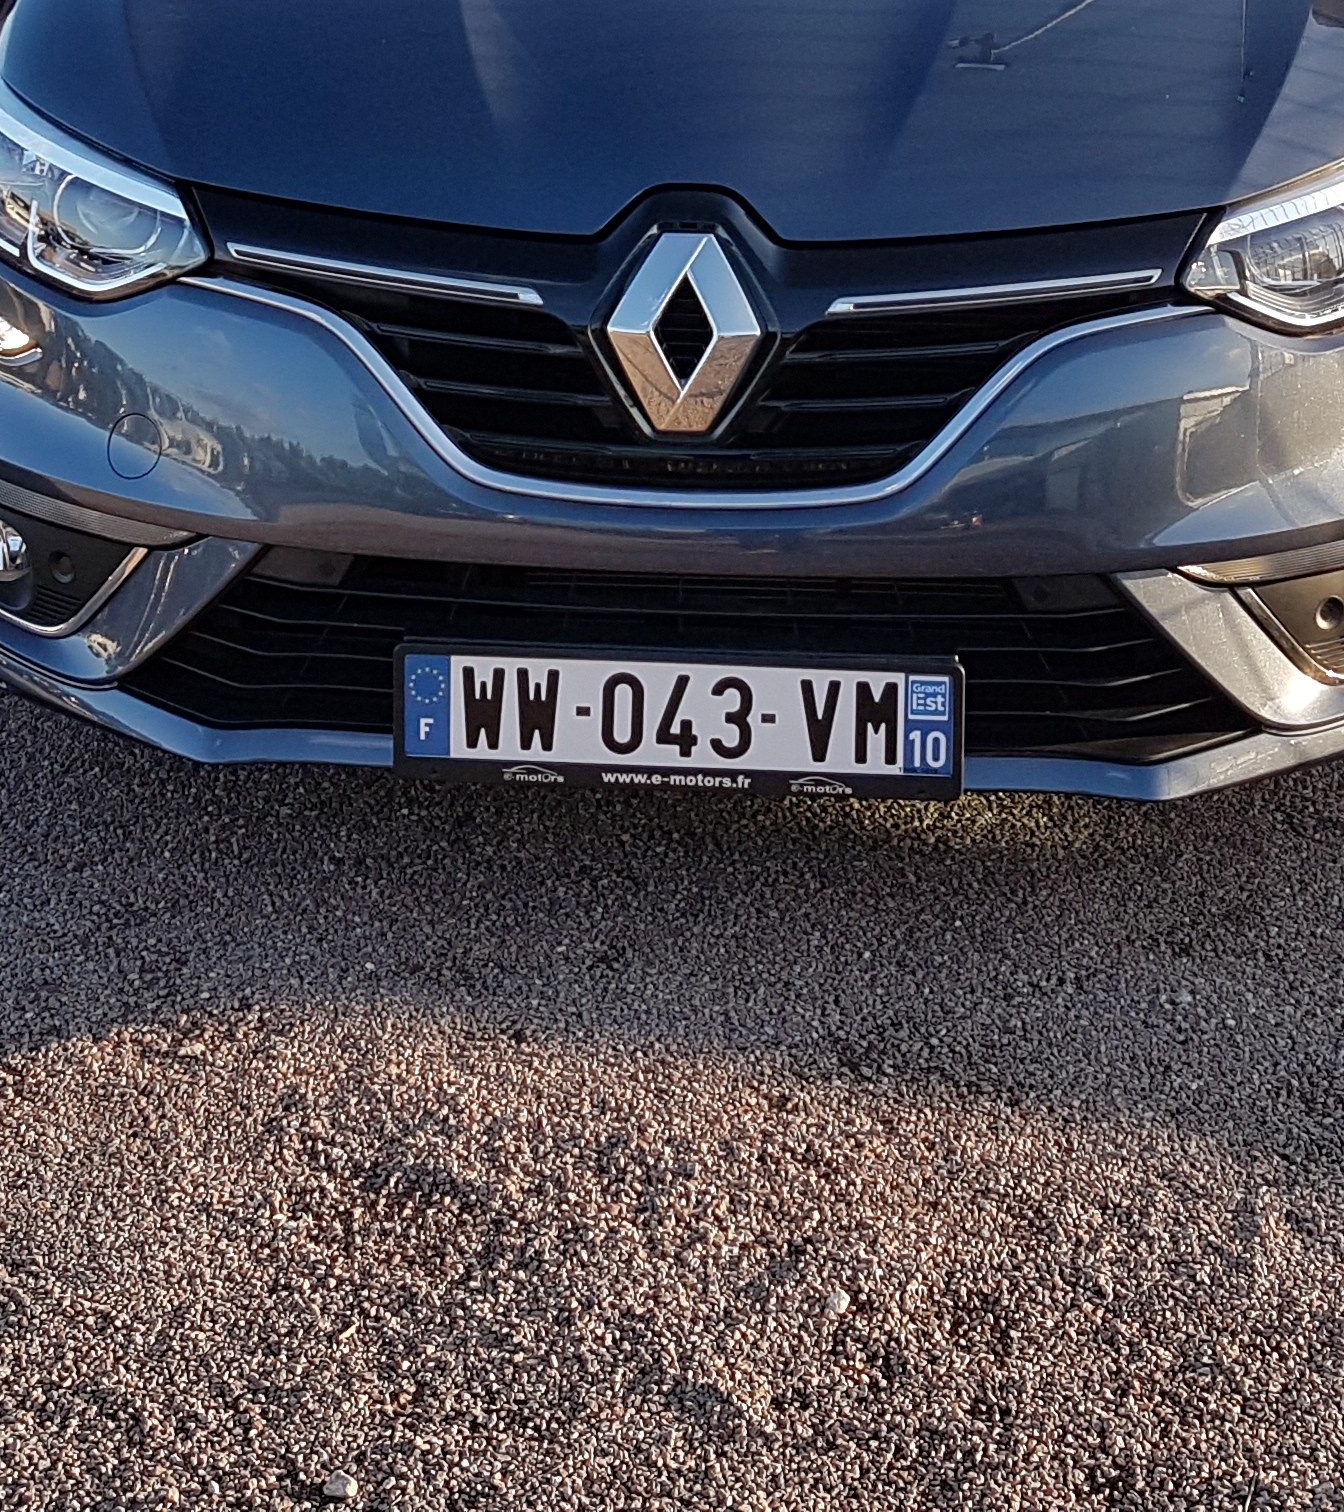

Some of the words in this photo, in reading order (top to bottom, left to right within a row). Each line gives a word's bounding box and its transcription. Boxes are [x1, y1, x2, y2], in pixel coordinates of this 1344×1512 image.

[912, 683, 946, 694] Grand
[912, 694, 946, 711] Est
[420, 718, 434, 740] F
[462, 665, 899, 765] WW-043-VM
[909, 730, 947, 768] 10
[601, 772, 752, 789] www.e-motors.fr
